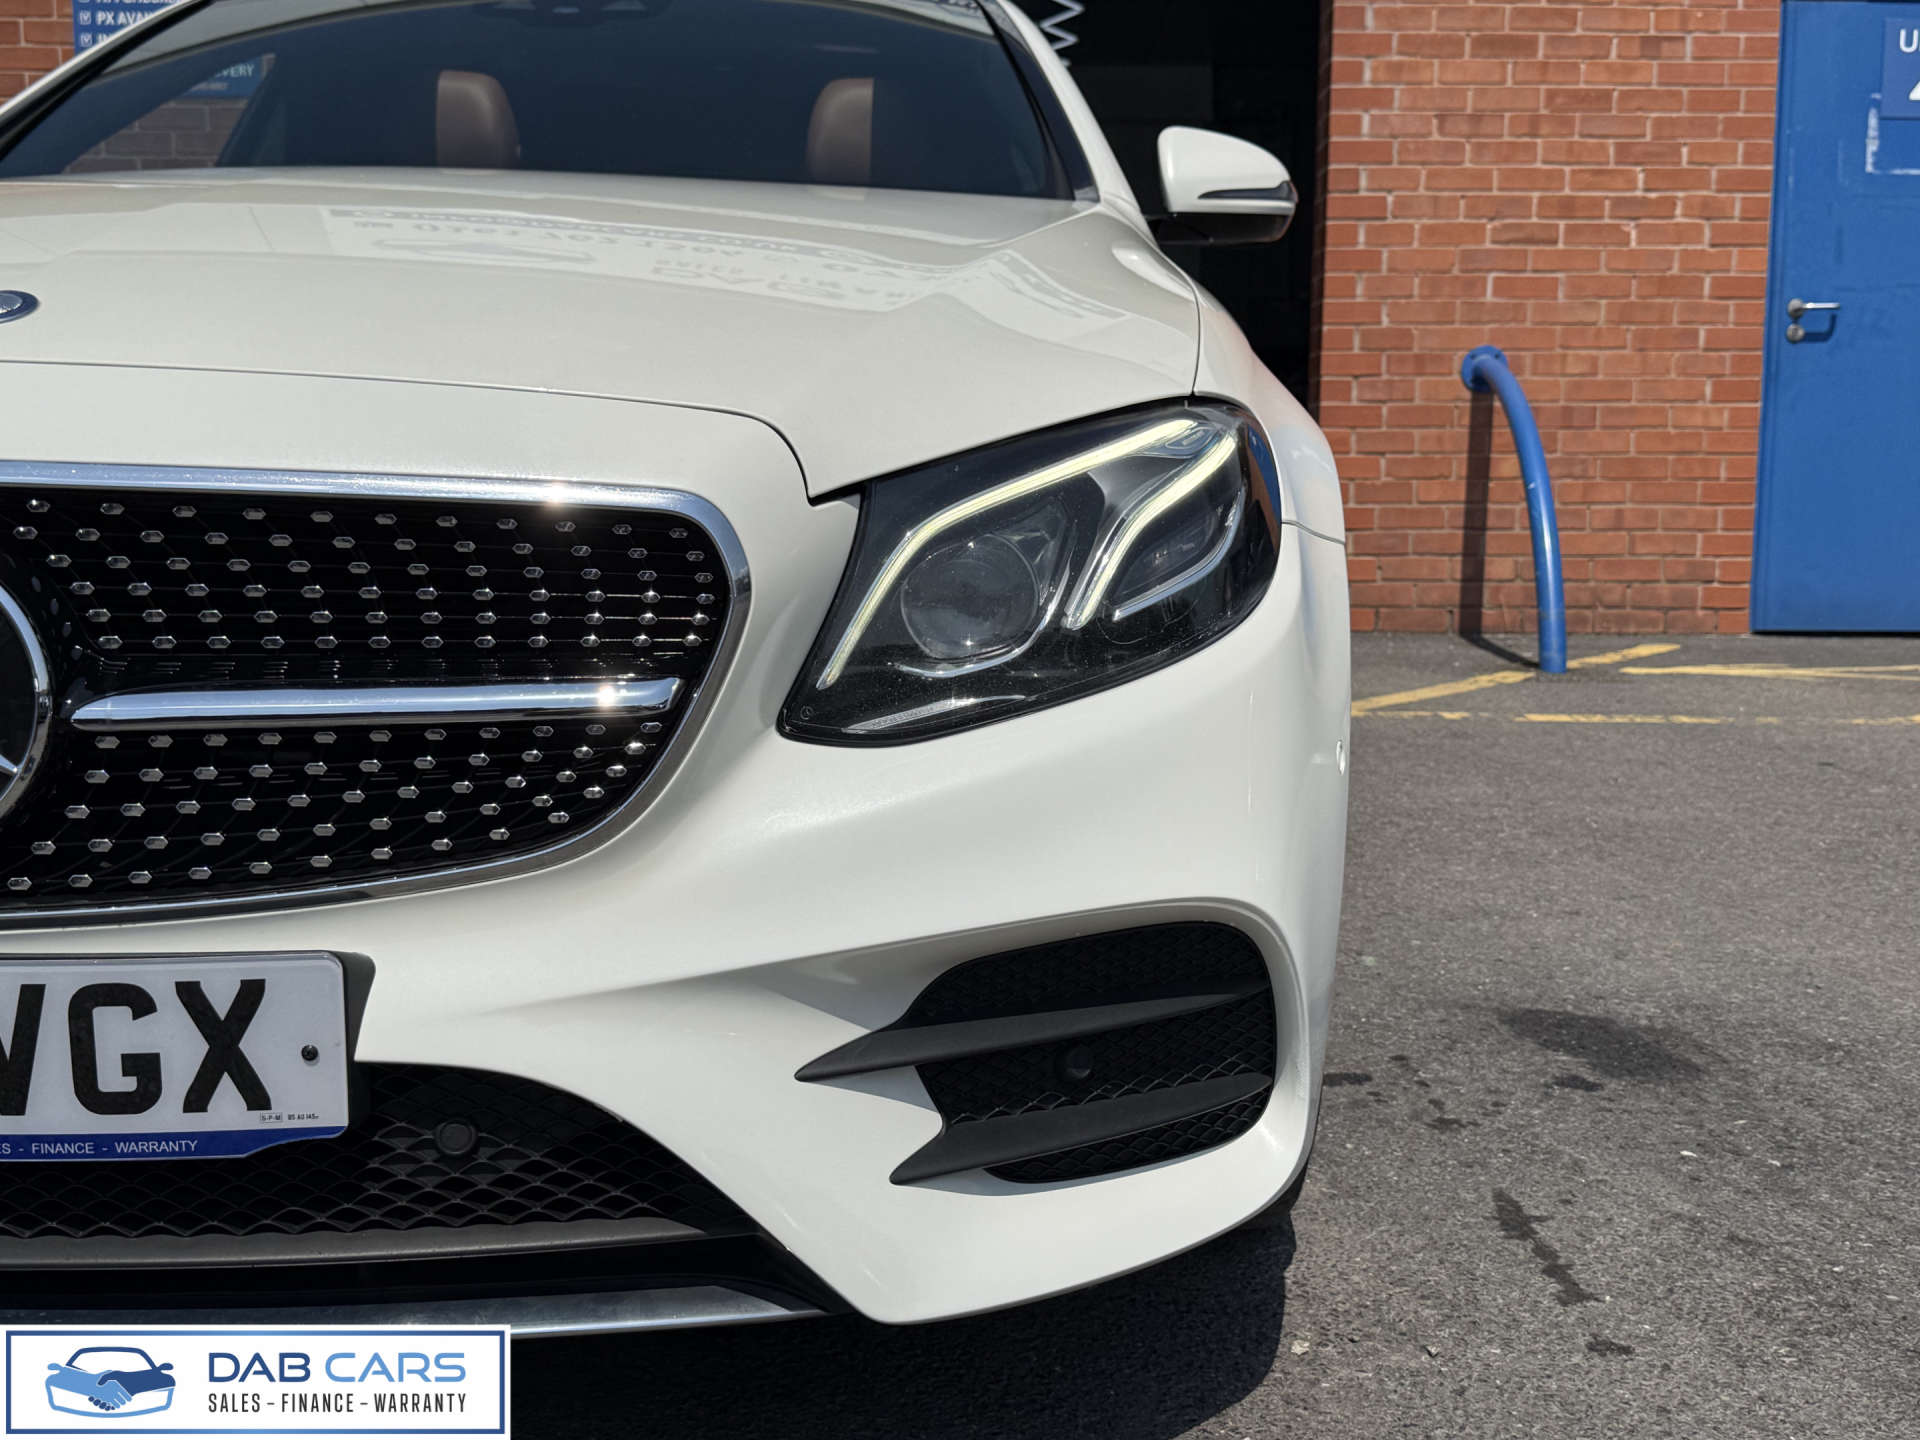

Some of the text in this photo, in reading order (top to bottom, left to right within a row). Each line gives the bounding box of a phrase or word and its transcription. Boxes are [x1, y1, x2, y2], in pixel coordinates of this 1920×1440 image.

[96, 11, 115, 25] PX
[31, 1142, 95, 1155] FINANCE
[114, 1140, 198, 1154] WARRANTY
